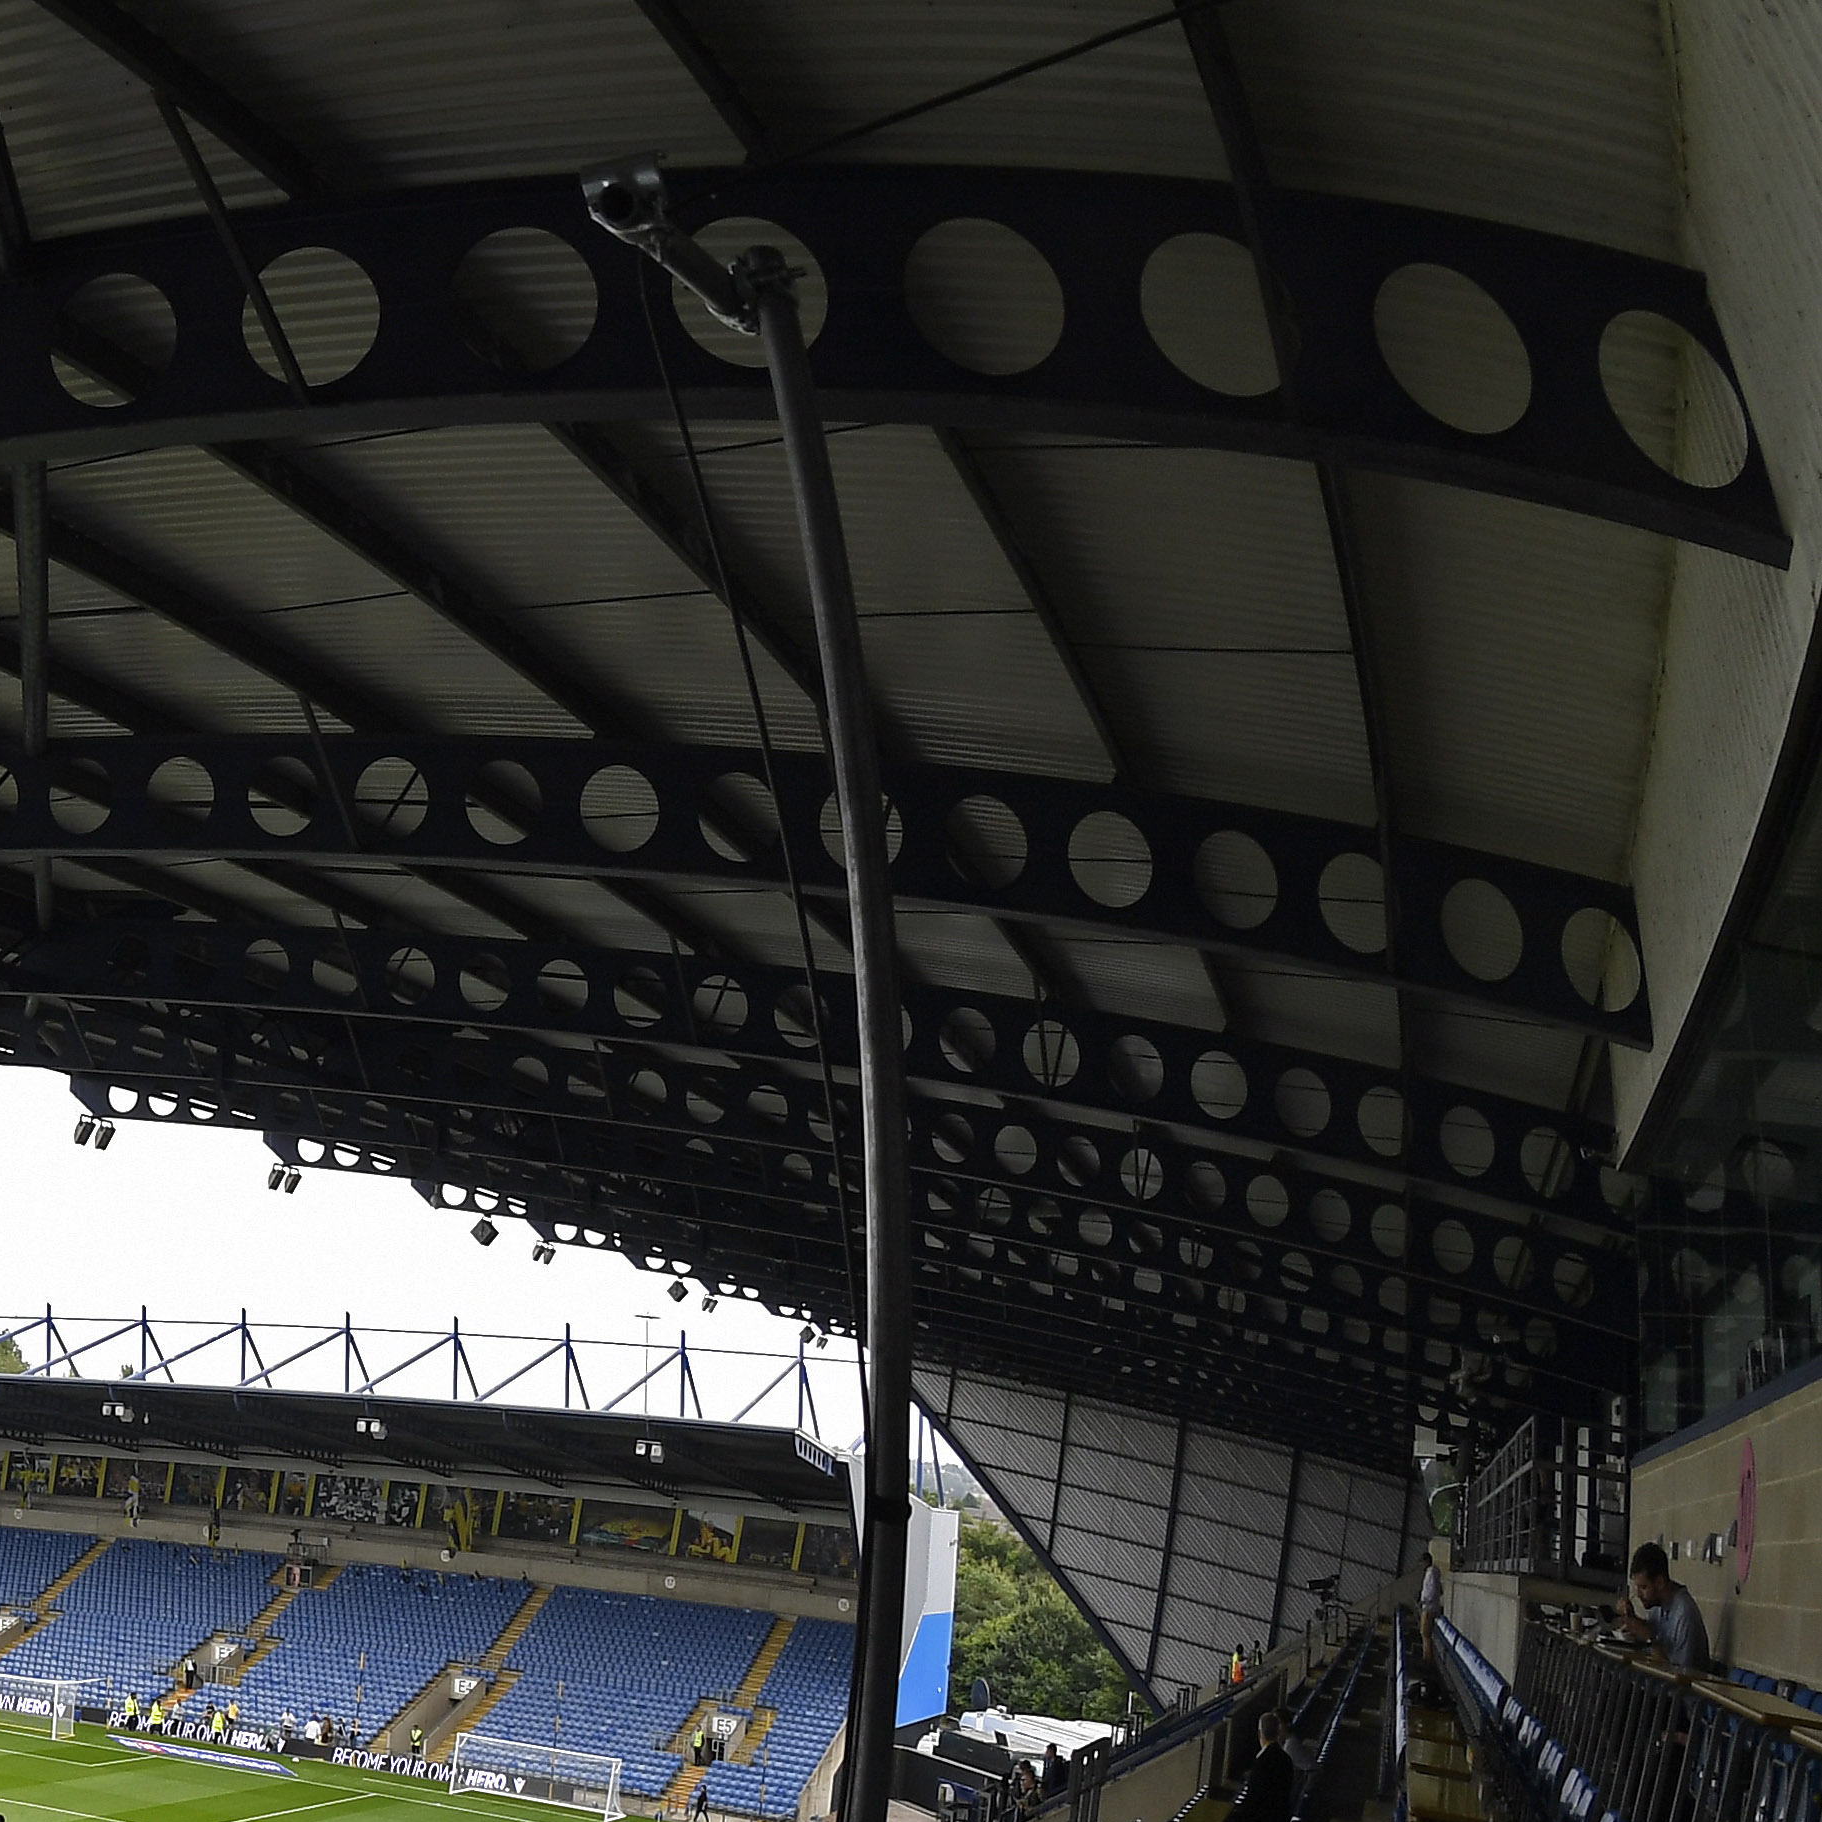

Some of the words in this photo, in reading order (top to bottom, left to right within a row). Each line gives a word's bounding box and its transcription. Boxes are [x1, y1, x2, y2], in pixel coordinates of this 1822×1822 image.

[16, 1695, 54, 1718] HERO.
[717, 1719, 732, 1734] E5
[389, 1754, 427, 1780] YOUR
[465, 1768, 511, 1792] HERO.
